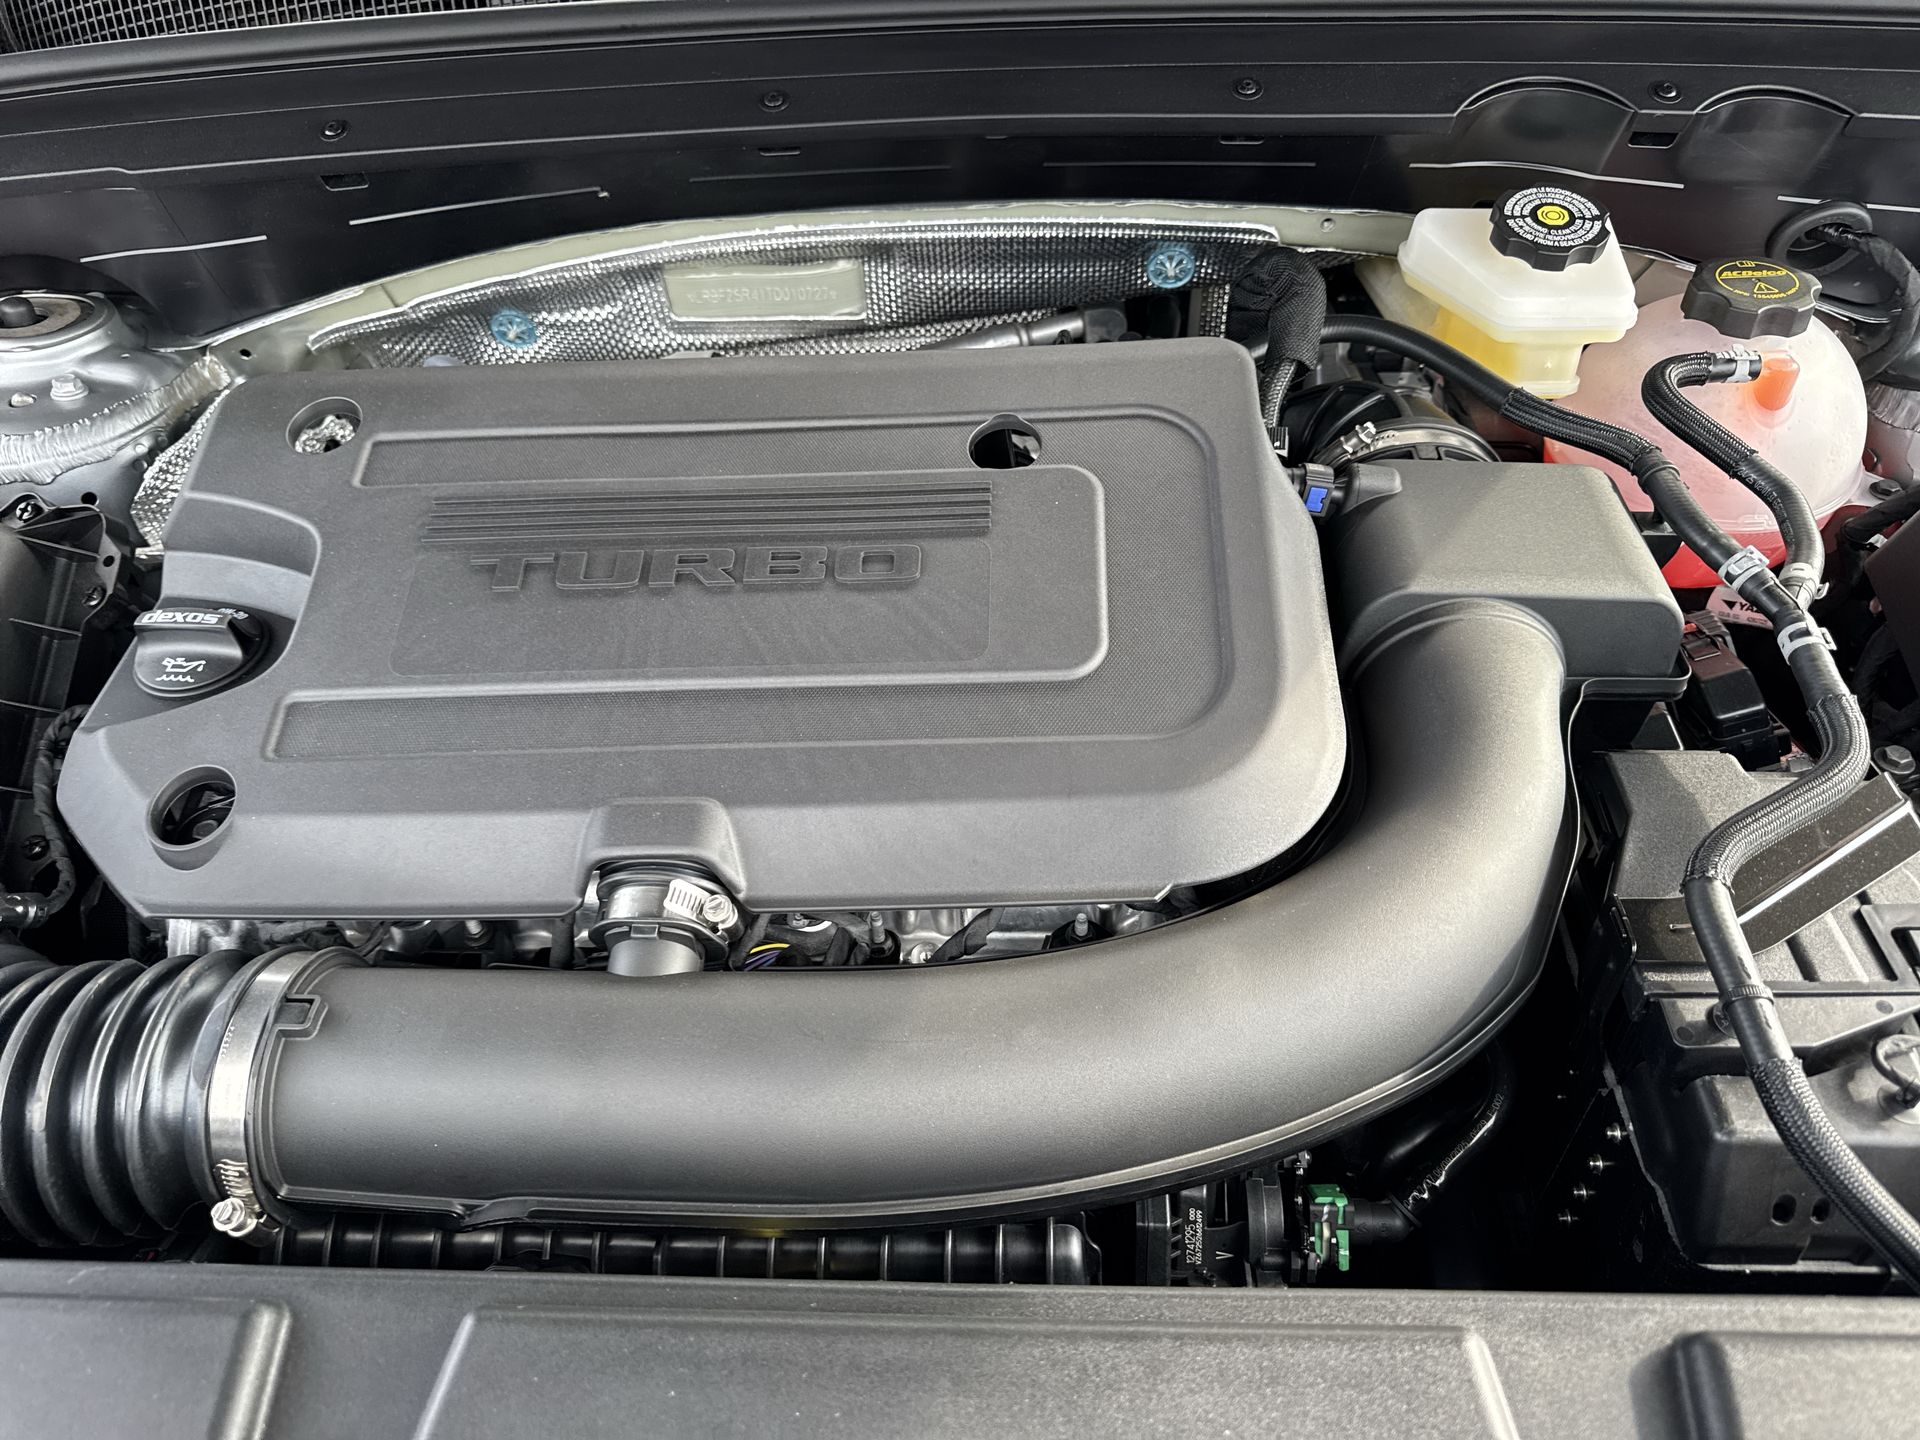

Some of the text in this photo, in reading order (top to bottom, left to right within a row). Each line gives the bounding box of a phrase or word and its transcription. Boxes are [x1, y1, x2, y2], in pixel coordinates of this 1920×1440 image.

[1534, 237, 1554, 246] FROM
[1559, 238, 1584, 247] SEALED
[469, 544, 922, 593] TURBO
[141, 609, 220, 624] dexos
[1184, 1224, 1196, 1264] 12741295
